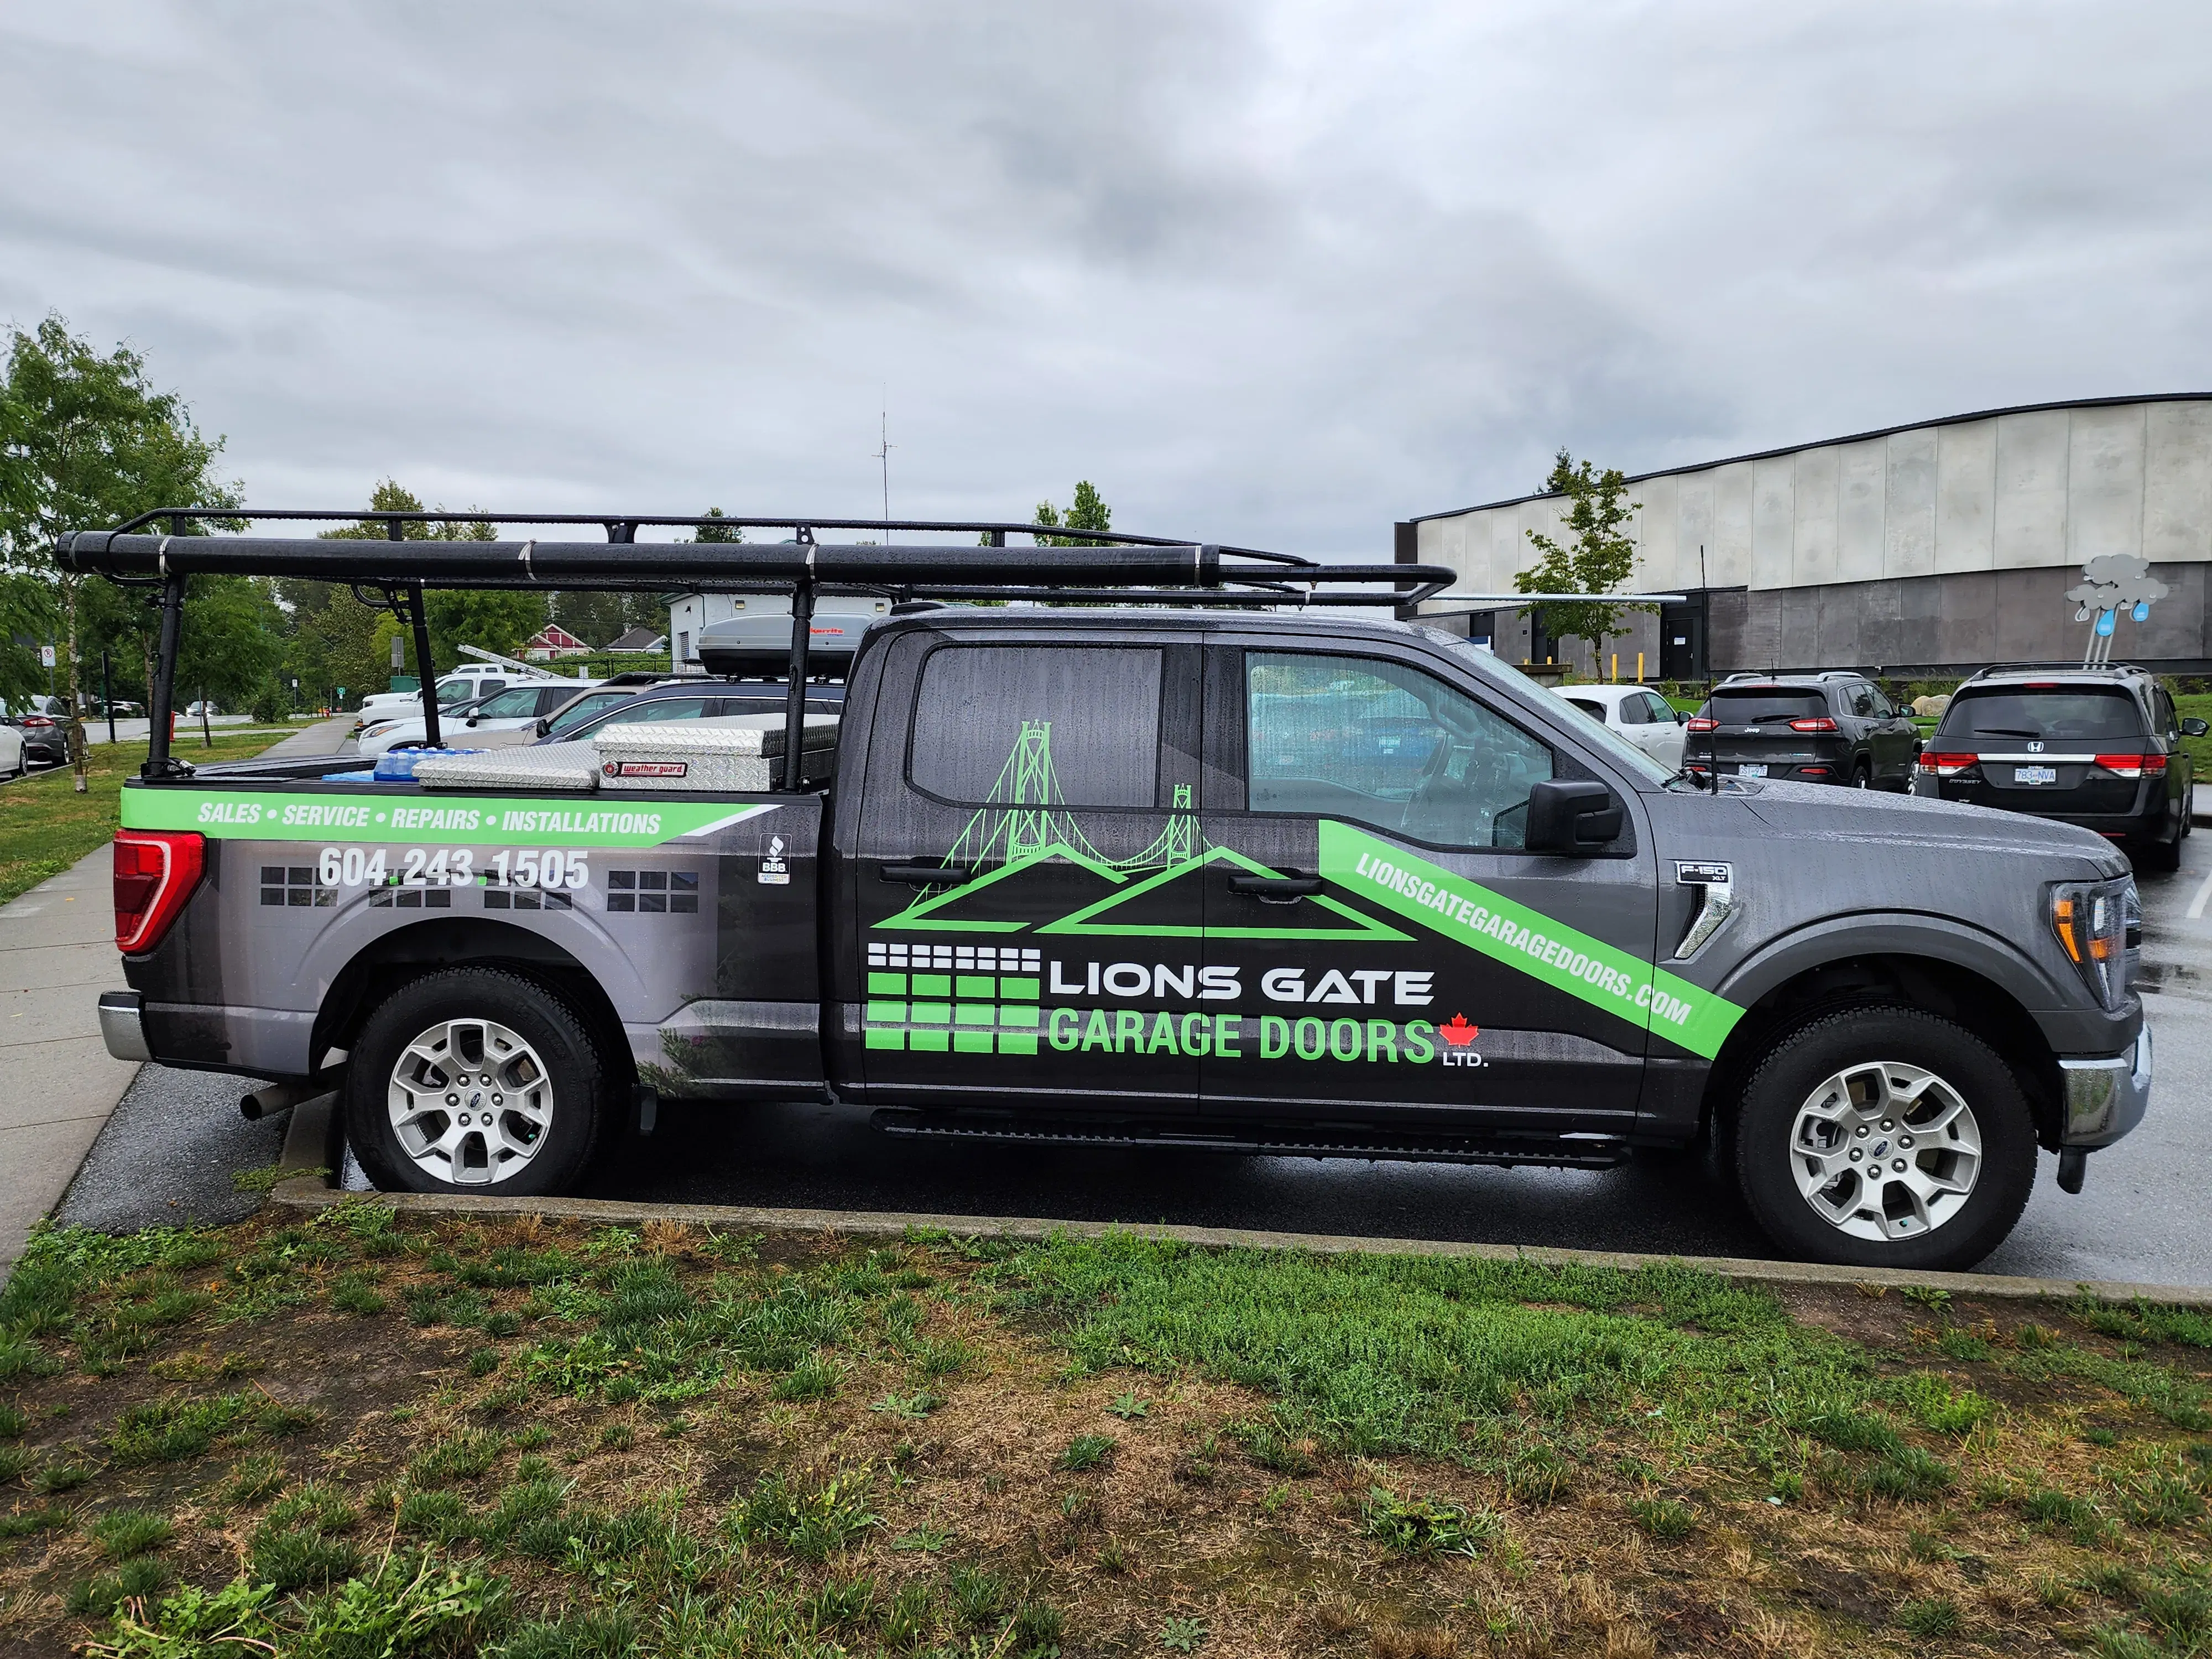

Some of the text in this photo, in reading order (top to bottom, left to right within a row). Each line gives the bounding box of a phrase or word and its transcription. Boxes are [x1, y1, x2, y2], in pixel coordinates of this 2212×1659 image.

[659, 765, 682, 774] guard
[2016, 770, 2055, 780] 783 NVA
[197, 801, 662, 835] SALES SERVICE REPAIRS INSTALLATIONS
[763, 862, 786, 872] BBB
[1681, 865, 1727, 875] F-150
[1355, 852, 1693, 1026] LIONSGATEGARAGEDOORS.COM
[1050, 961, 1436, 1005] LIONS GATE
[1048, 1008, 1434, 1064] GARAGE DOORS
[1442, 1051, 1489, 1068] LTD.
